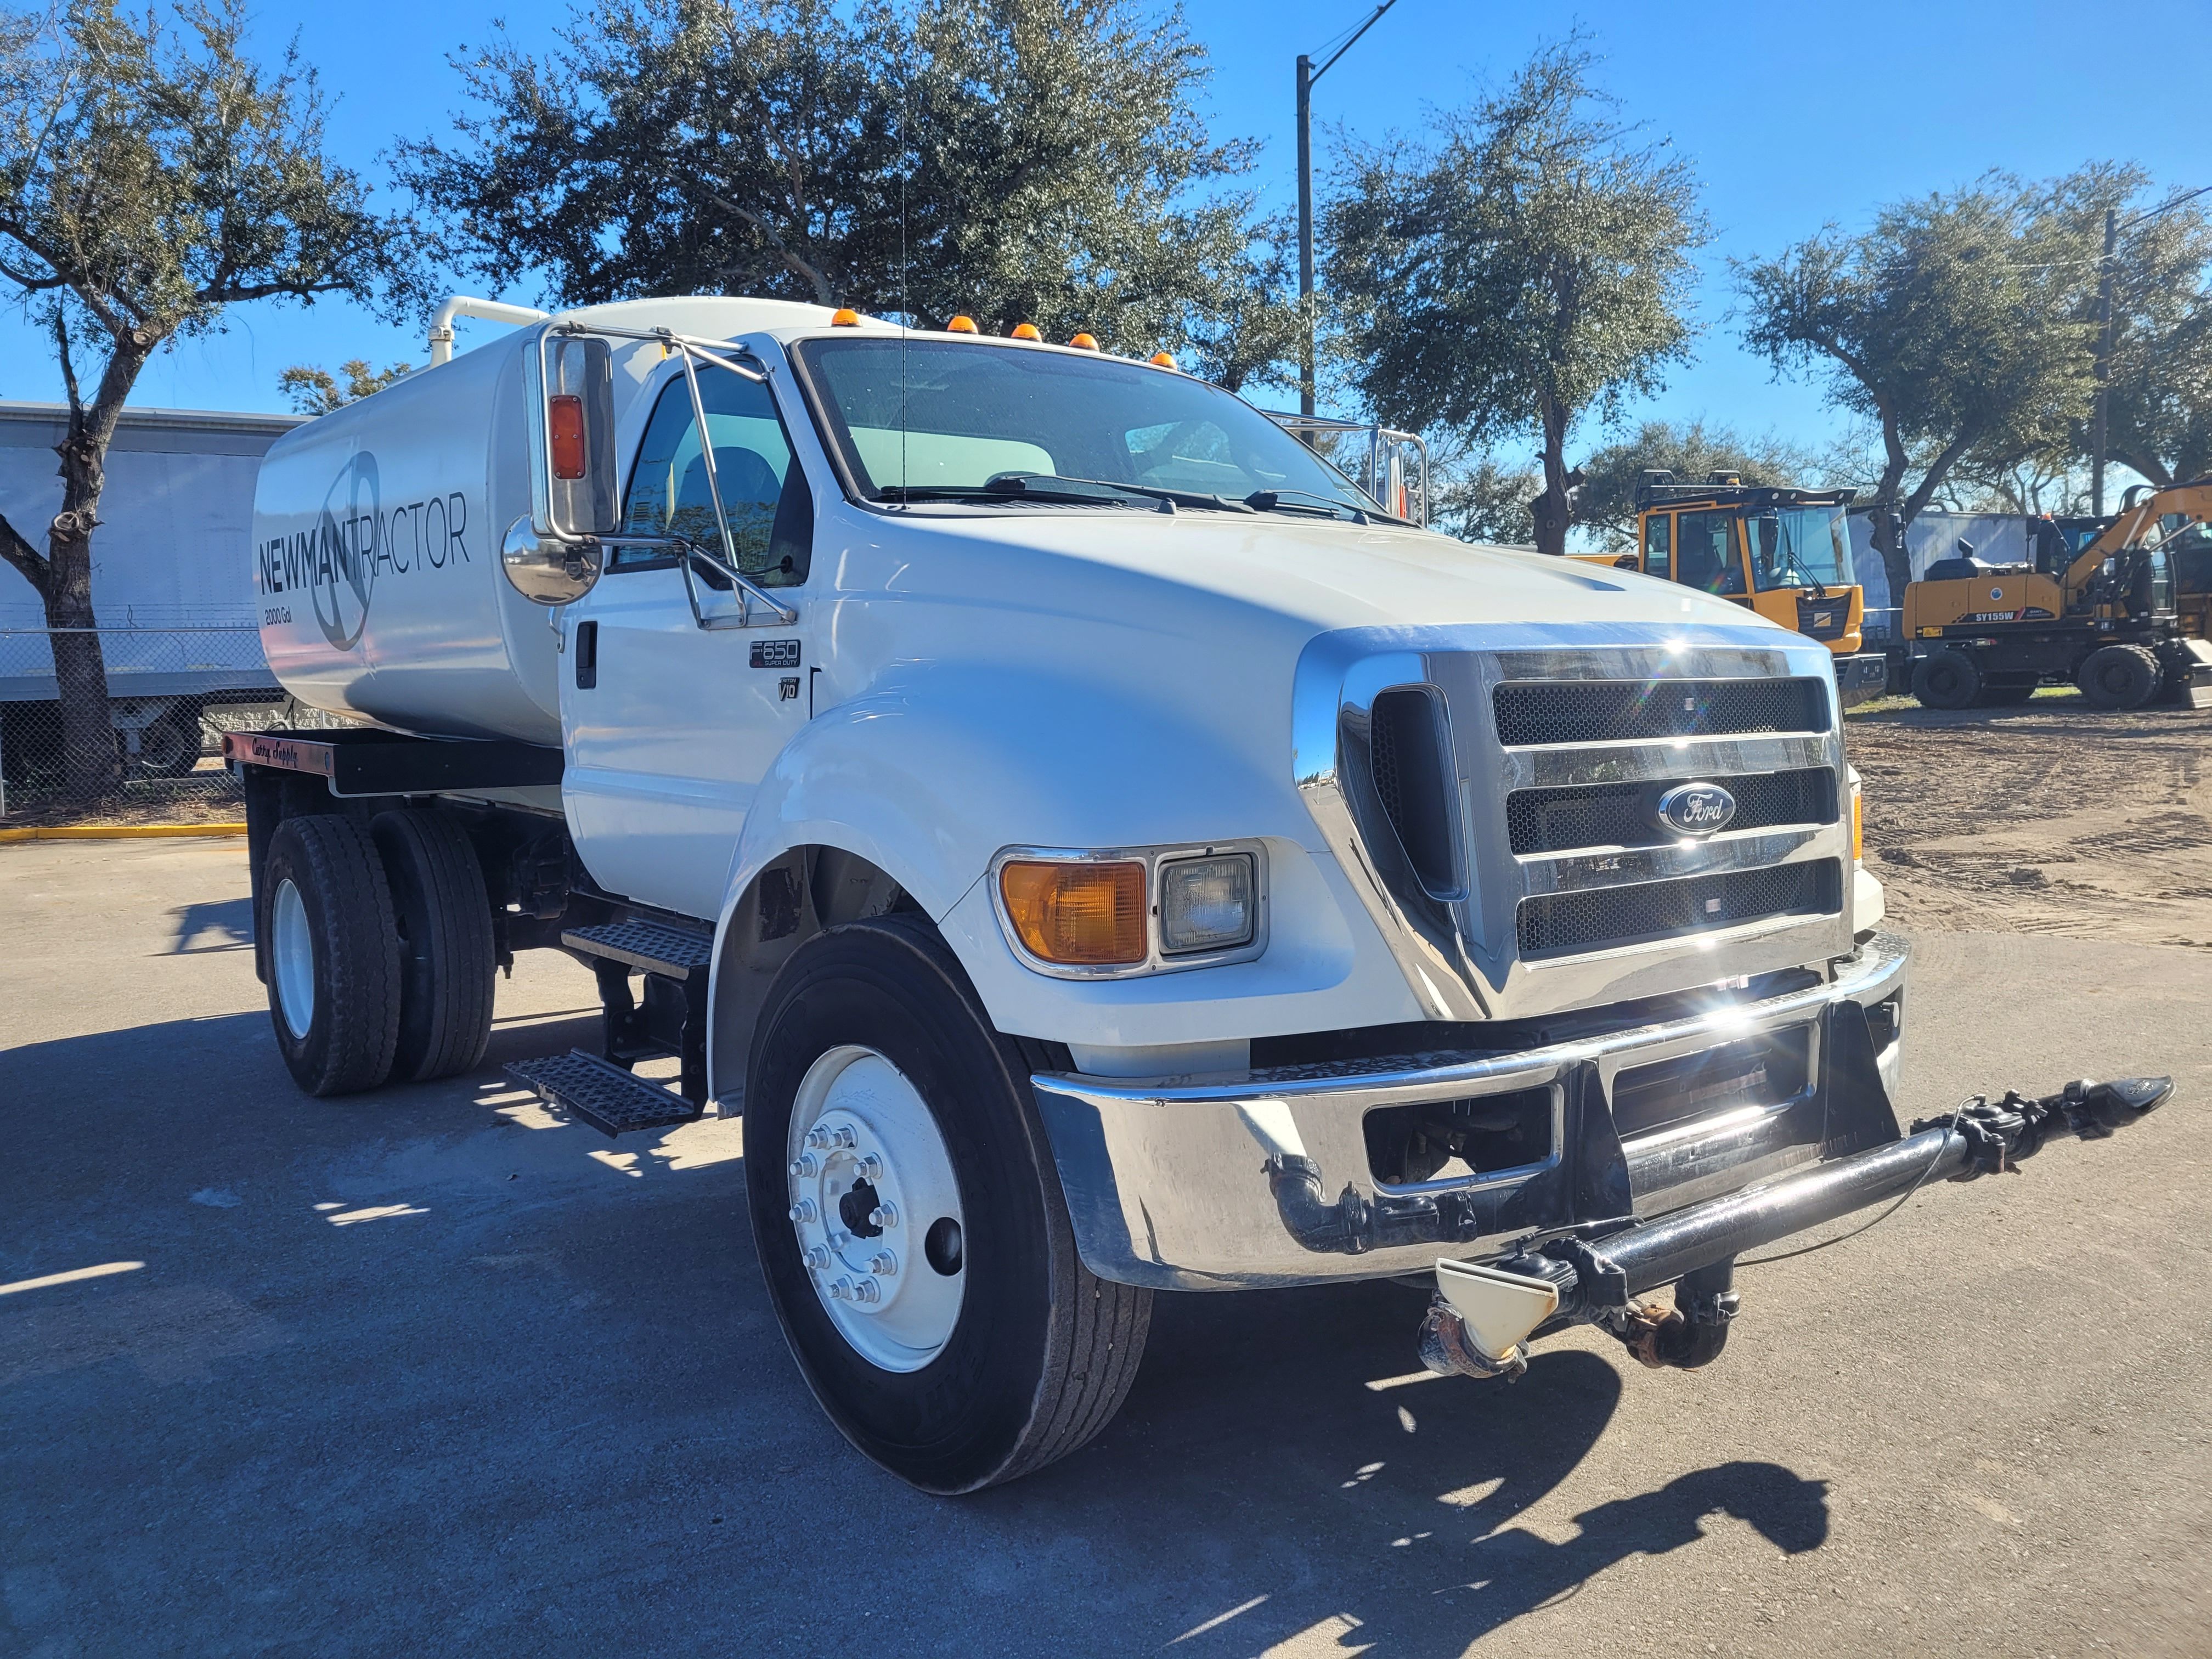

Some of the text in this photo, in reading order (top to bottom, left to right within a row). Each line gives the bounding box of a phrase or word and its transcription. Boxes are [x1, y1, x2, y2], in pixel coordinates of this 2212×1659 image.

[264, 606, 292, 625] 2000 Gal
[1976, 611, 2015, 622] SY155W
[778, 684, 795, 701] V10
[252, 737, 298, 769] Curry Supply
[1683, 793, 1724, 822] Ford
